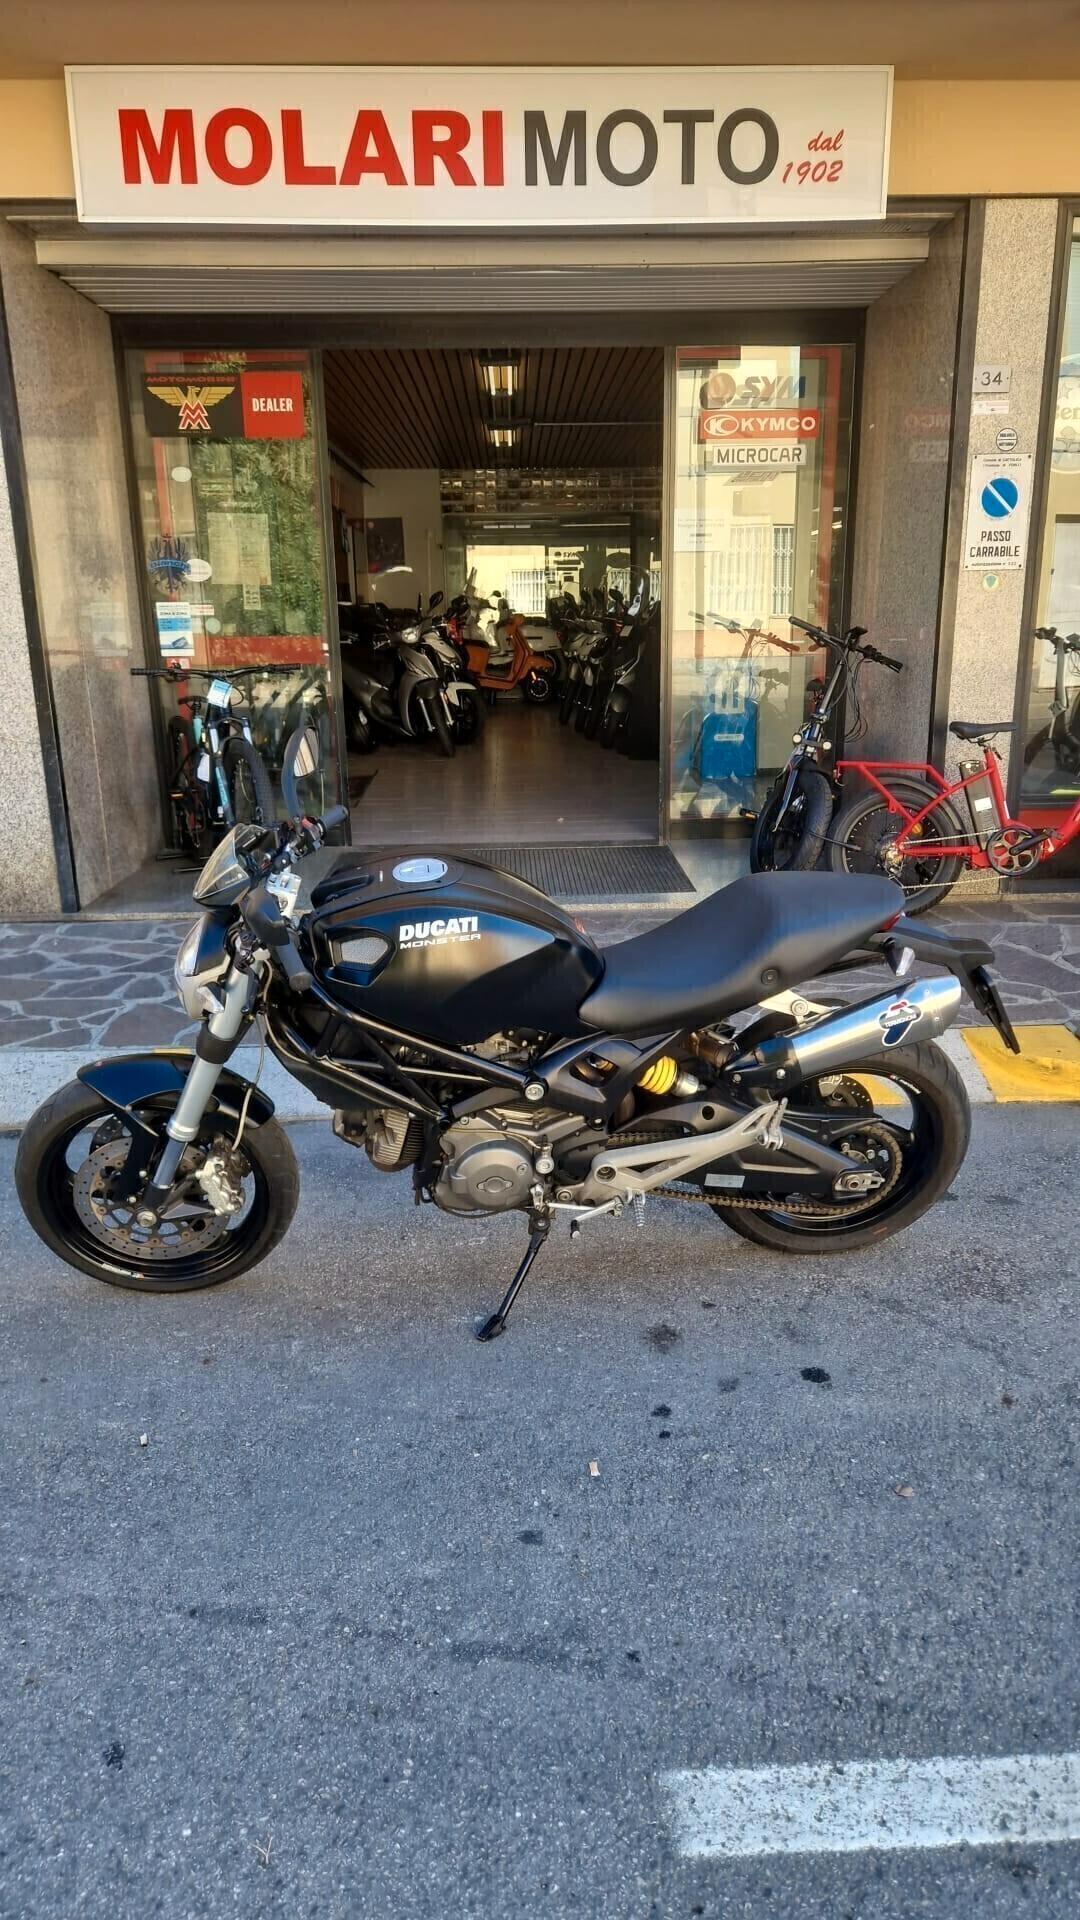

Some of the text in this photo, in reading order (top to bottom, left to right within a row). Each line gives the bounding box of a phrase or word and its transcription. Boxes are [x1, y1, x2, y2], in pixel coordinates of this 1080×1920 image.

[118, 108, 780, 187] MOLARI MOTO
[808, 129, 845, 152] dal
[782, 160, 844, 185] 1902
[981, 371, 1002, 386] 34
[251, 397, 294, 412] DEALER
[741, 416, 816, 432] KYMCO
[717, 447, 802, 464] MICROCAR
[980, 530, 1011, 543] PASSO
[969, 545, 1020, 558] CARRABILE
[399, 916, 479, 942] DUCATI
[399, 933, 482, 950] MONSTER
